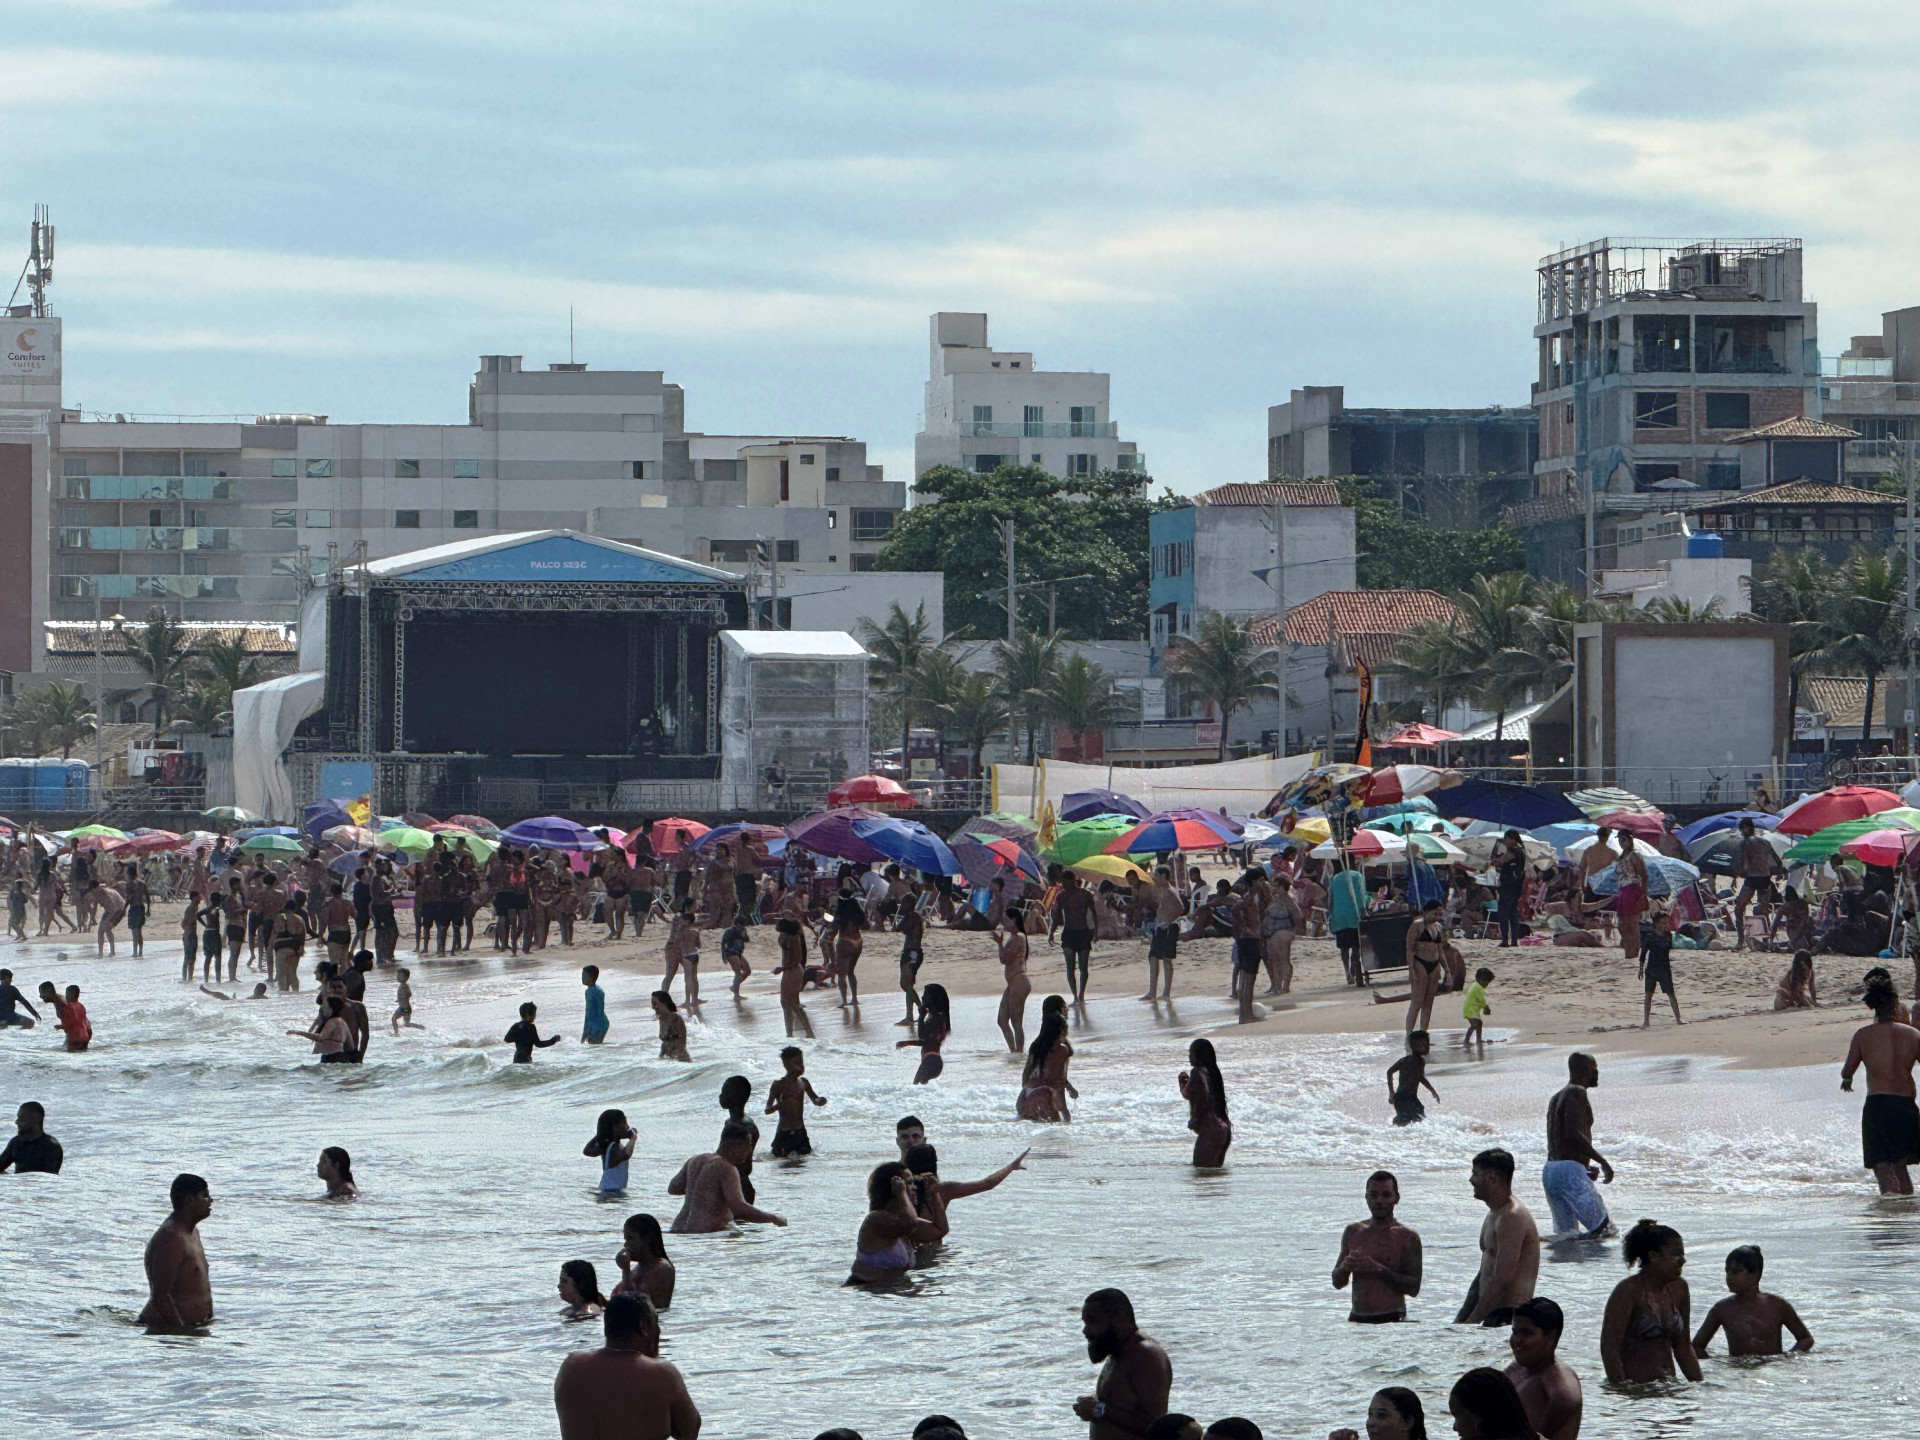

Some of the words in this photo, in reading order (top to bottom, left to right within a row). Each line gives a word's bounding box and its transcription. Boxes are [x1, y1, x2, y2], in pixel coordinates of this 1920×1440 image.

[8, 352, 46, 361] Comfort
[530, 561, 561, 569] PALCO
[563, 561, 587, 569] SESC
